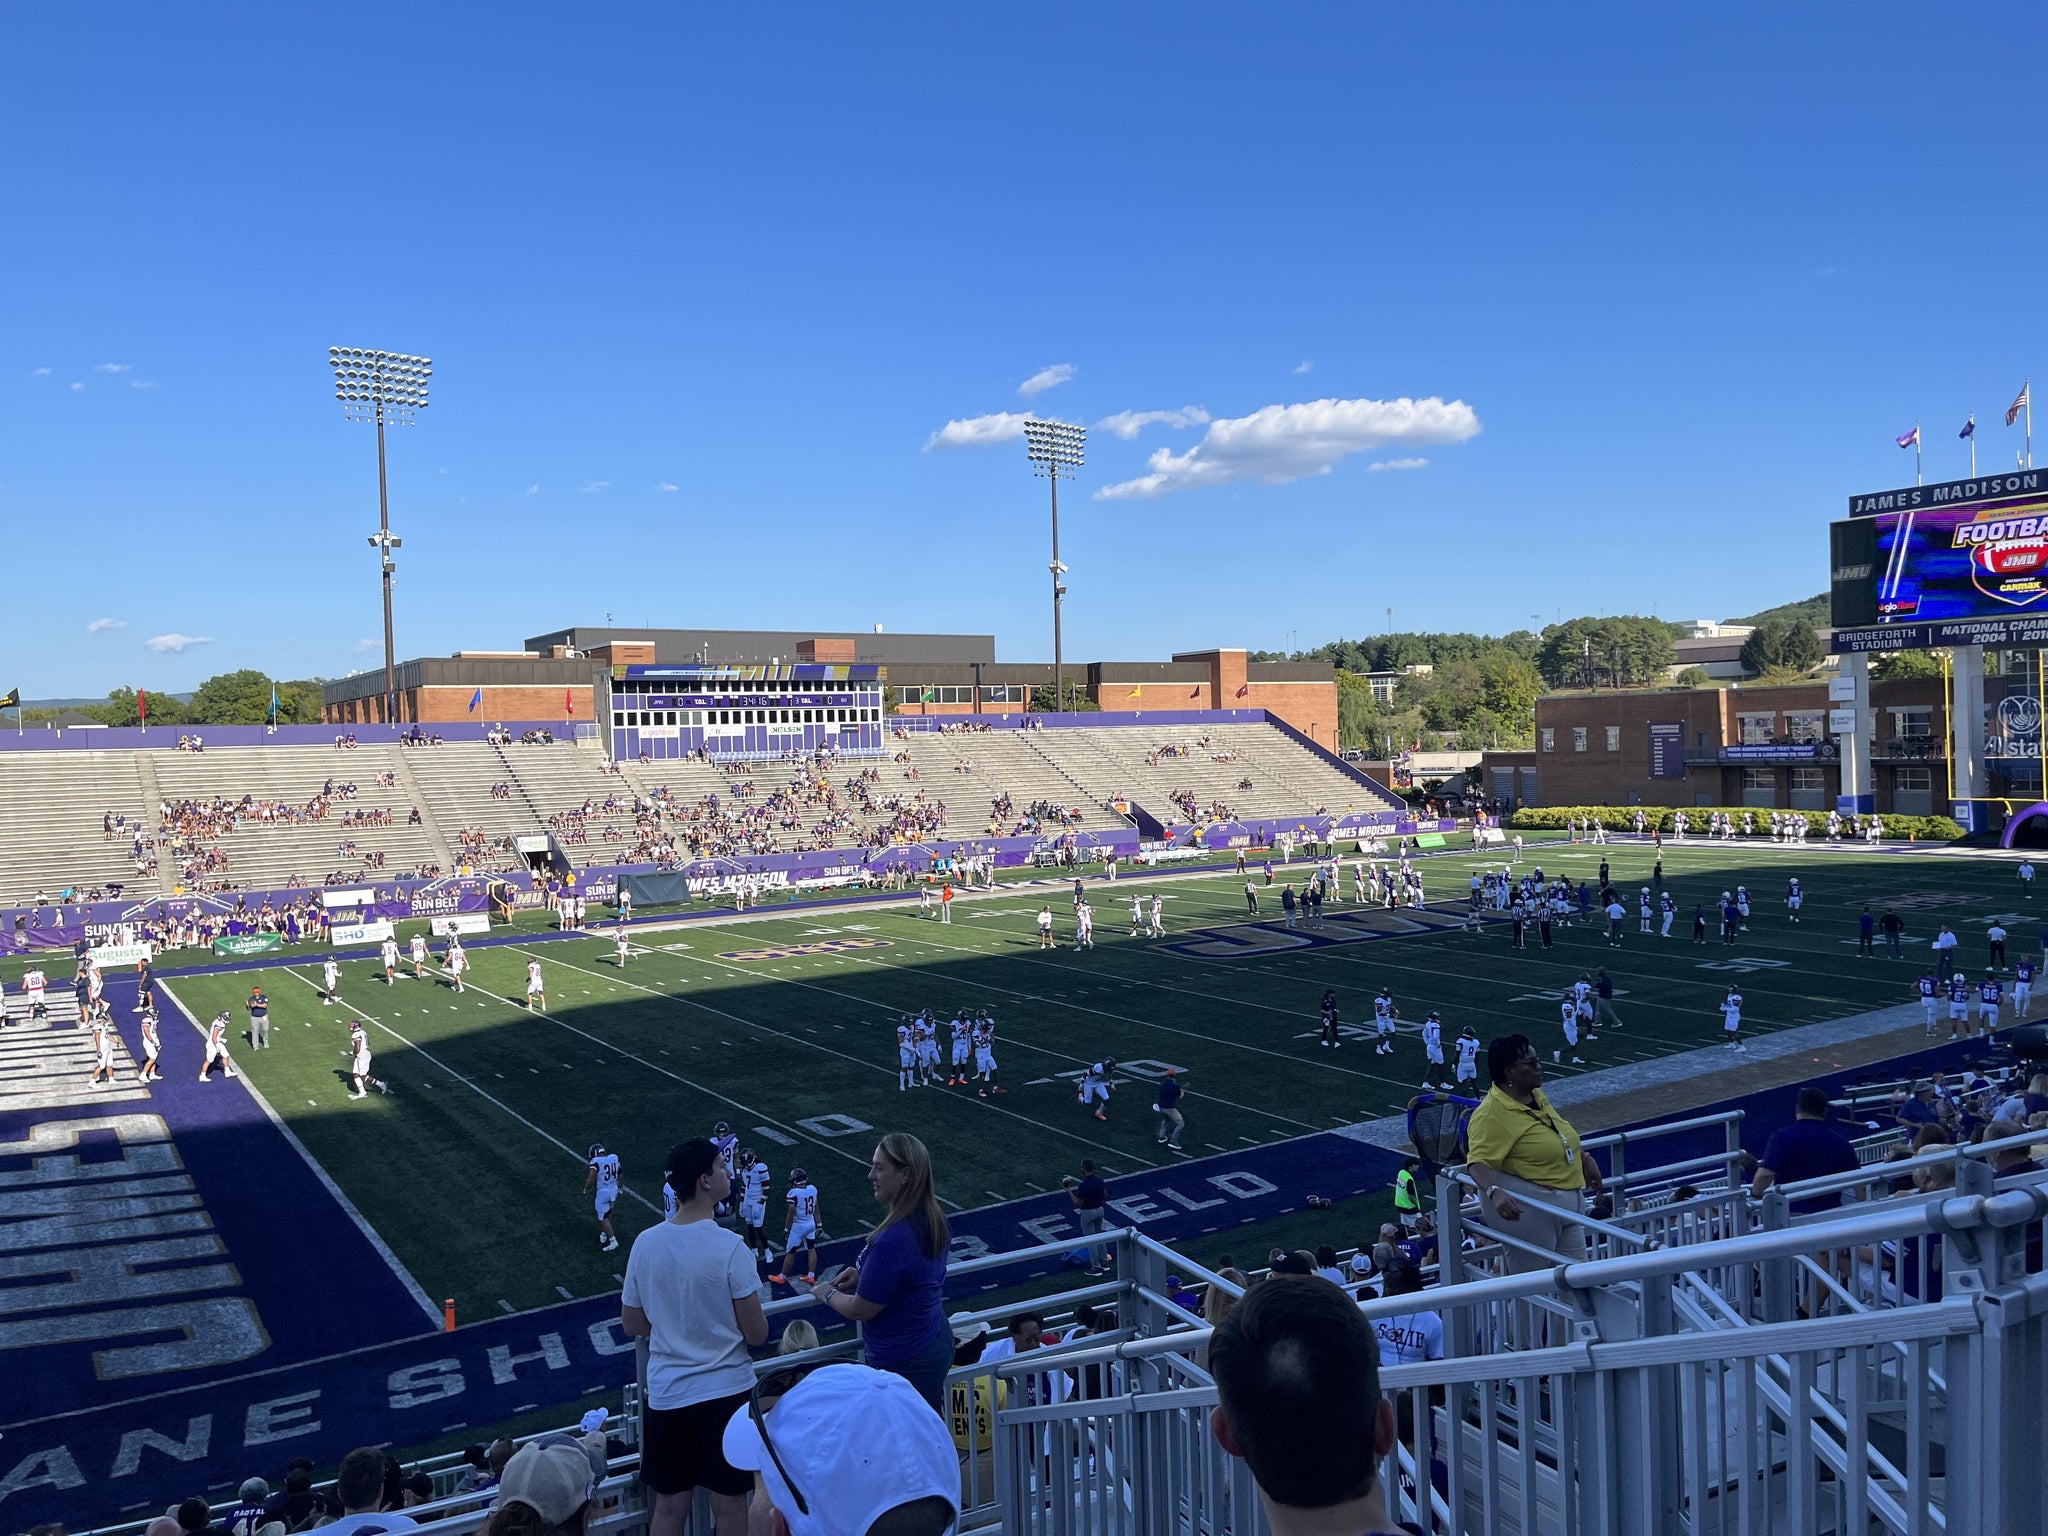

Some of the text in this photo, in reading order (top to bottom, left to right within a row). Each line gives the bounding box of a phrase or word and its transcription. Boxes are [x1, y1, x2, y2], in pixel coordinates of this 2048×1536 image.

[1855, 474, 2038, 512] JAMES MADISON
[1955, 517, 2048, 545] FOOTBA
[2002, 552, 2038, 568] JMU
[1832, 564, 1874, 582] JMU
[1941, 619, 2048, 636] NATIONAL CHAM
[1838, 629, 1916, 642] BRIDGEFORTH
[1972, 631, 2007, 644] 2004
[1852, 639, 1903, 650] STADIUM
[677, 697, 684, 707] 0
[743, 696, 767, 706] 34:16
[827, 696, 832, 704] 0
[1358, 823, 1397, 836] MADISON
[1229, 834, 1250, 847] JMU
[824, 866, 842, 877] SUN
[585, 885, 606, 896] SUN
[411, 896, 460, 911] SUN BELT
[85, 924, 109, 937] SUN
[229, 938, 267, 950] Lakeside
[414, 942, 422, 951] 85
[86, 947, 144, 961] Augusta
[1695, 957, 1793, 973] 50
[30, 976, 40, 986] 60
[1983, 988, 1999, 1000] 96
[604, 1163, 617, 1181] 34
[745, 1174, 752, 1190] 7
[804, 1196, 814, 1215] 13
[1019, 1171, 1280, 1243] FELD
